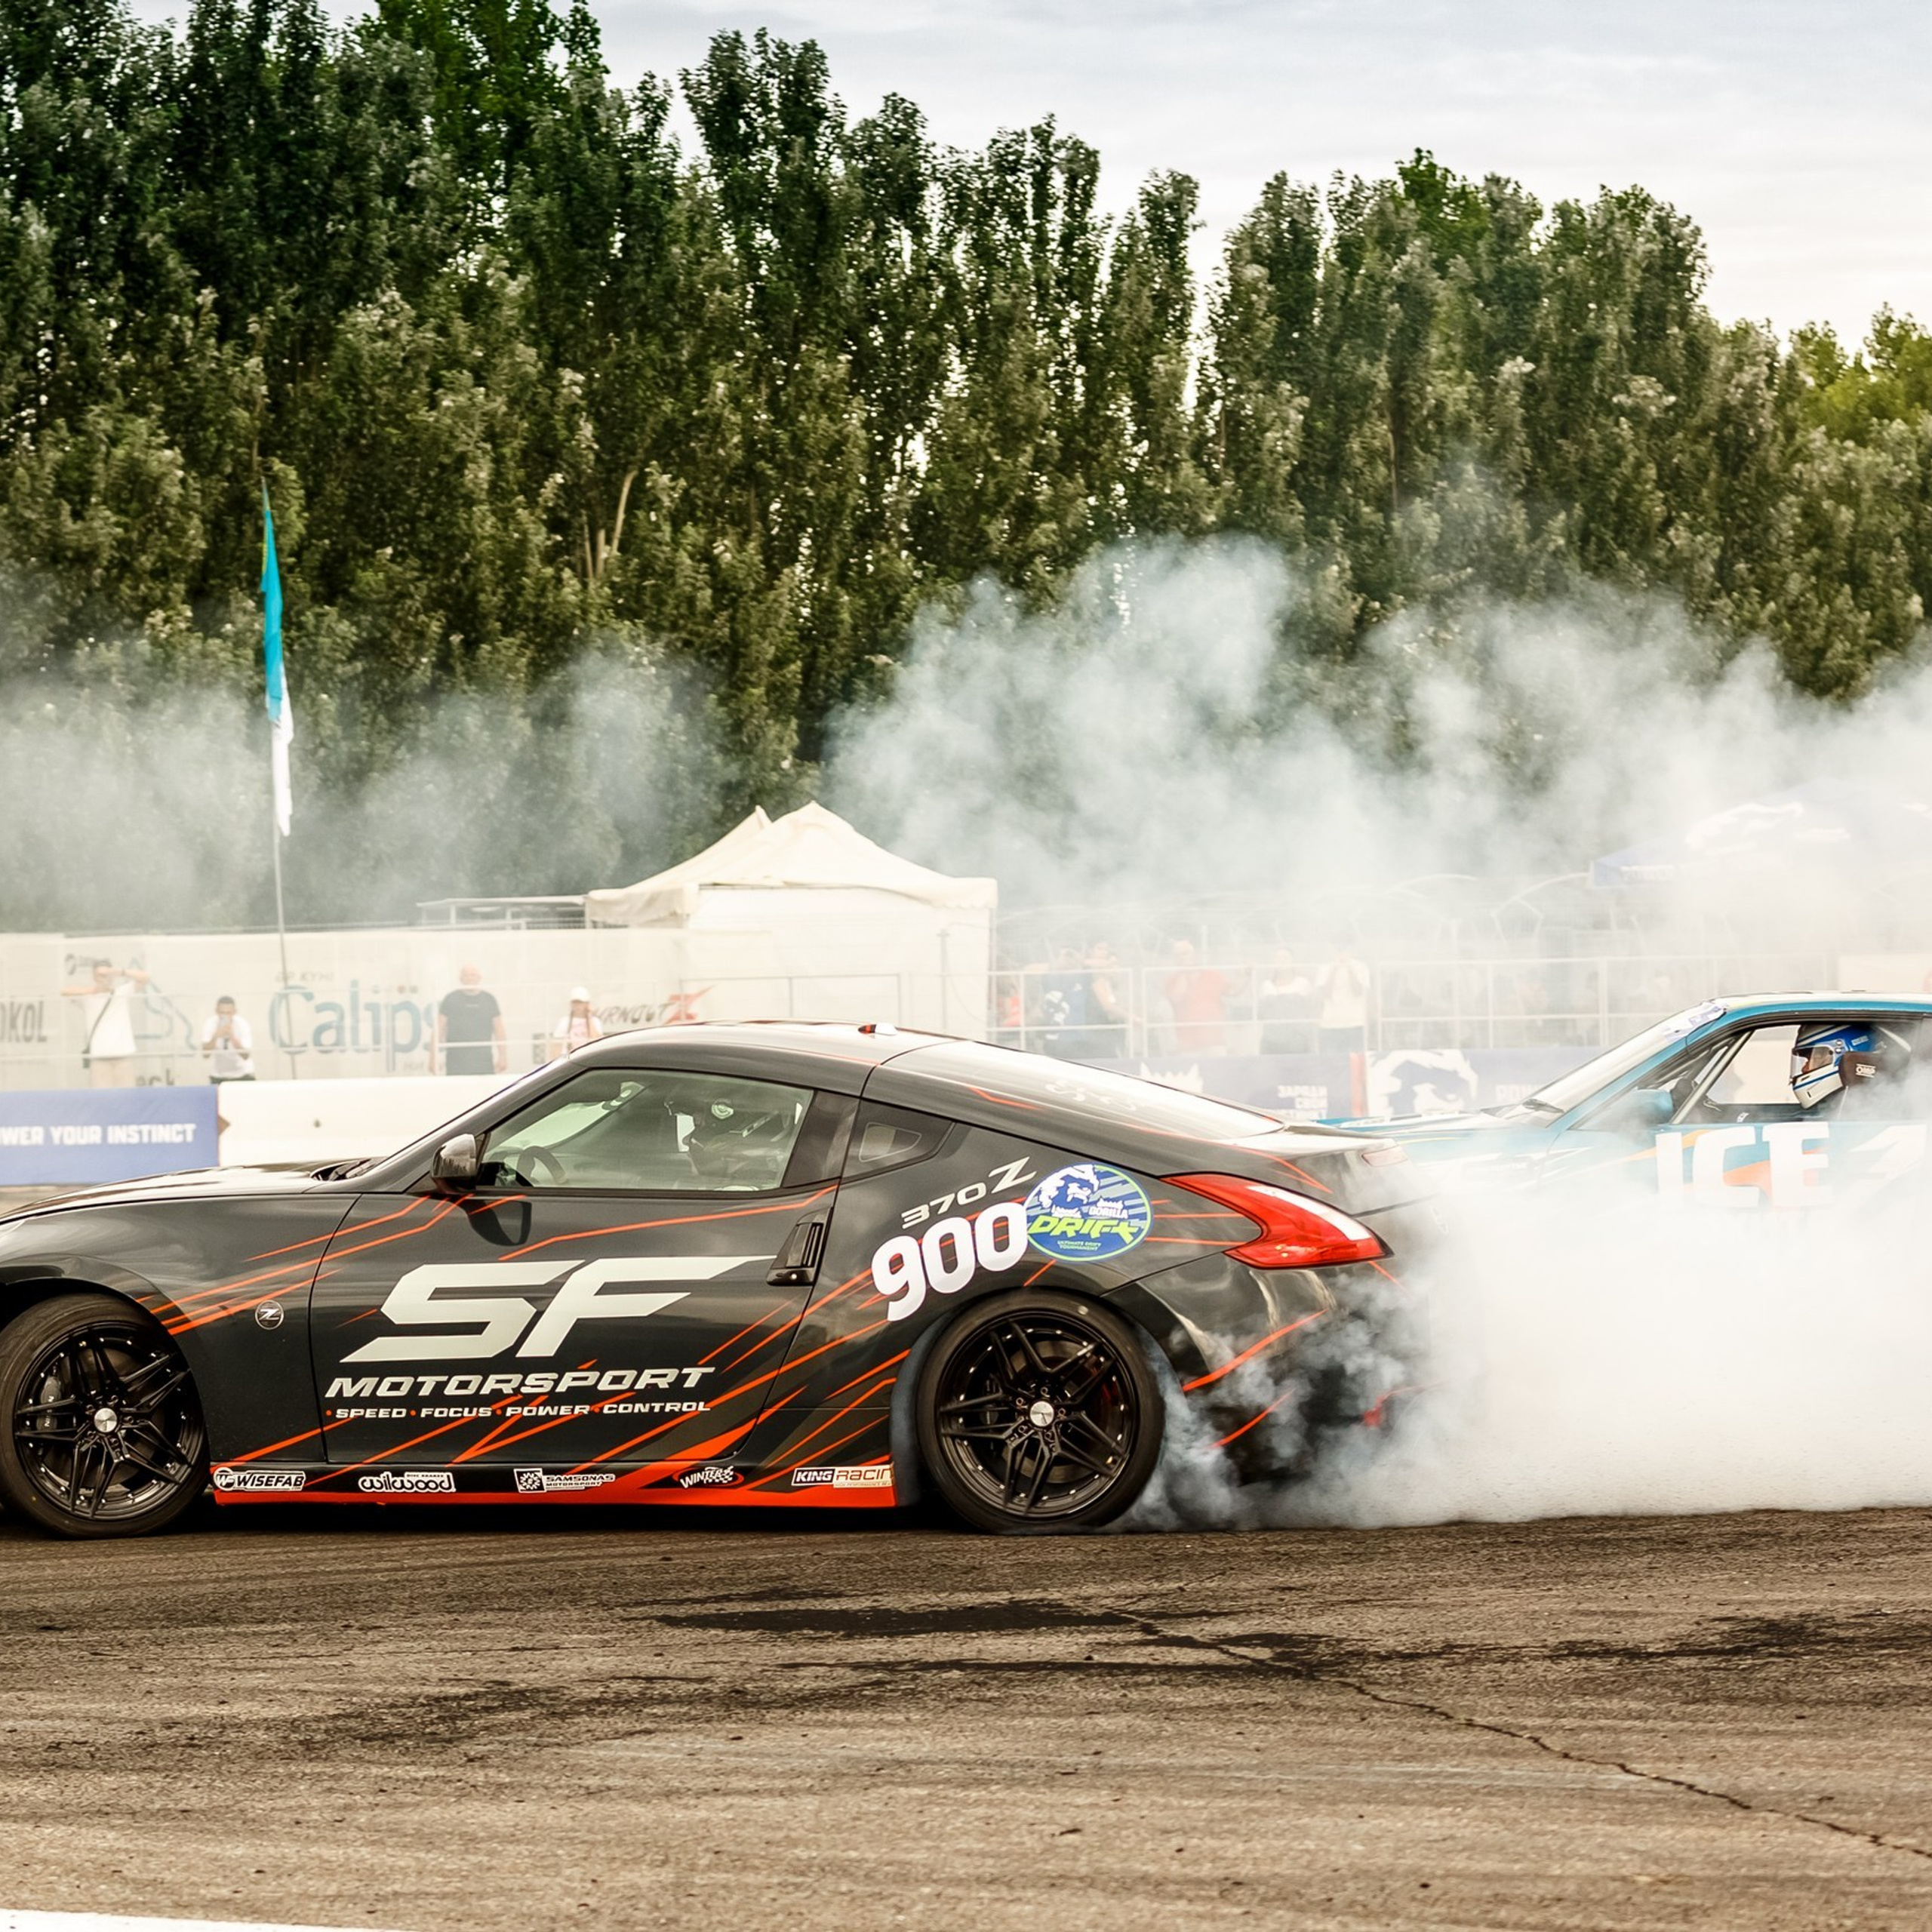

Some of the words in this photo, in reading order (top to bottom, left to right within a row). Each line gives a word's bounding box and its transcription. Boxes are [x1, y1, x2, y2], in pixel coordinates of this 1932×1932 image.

[0, 1126, 44, 1146] WER
[50, 1125, 102, 1145] YOUR
[107, 1124, 196, 1144] INSTINCT
[1028, 1214, 1140, 1244] DRIFT
[872, 1202, 1028, 1321] 900
[339, 1255, 778, 1363] SF
[325, 1367, 715, 1398] MOTORSPORT
[336, 1408, 406, 1419] SPEED
[420, 1407, 492, 1418] FOCUS
[506, 1405, 590, 1417] POWER
[603, 1401, 711, 1414] CONTROL
[237, 1475, 305, 1487] WISEFAB
[361, 1474, 453, 1491] wilwood
[795, 1471, 833, 1482] KING
